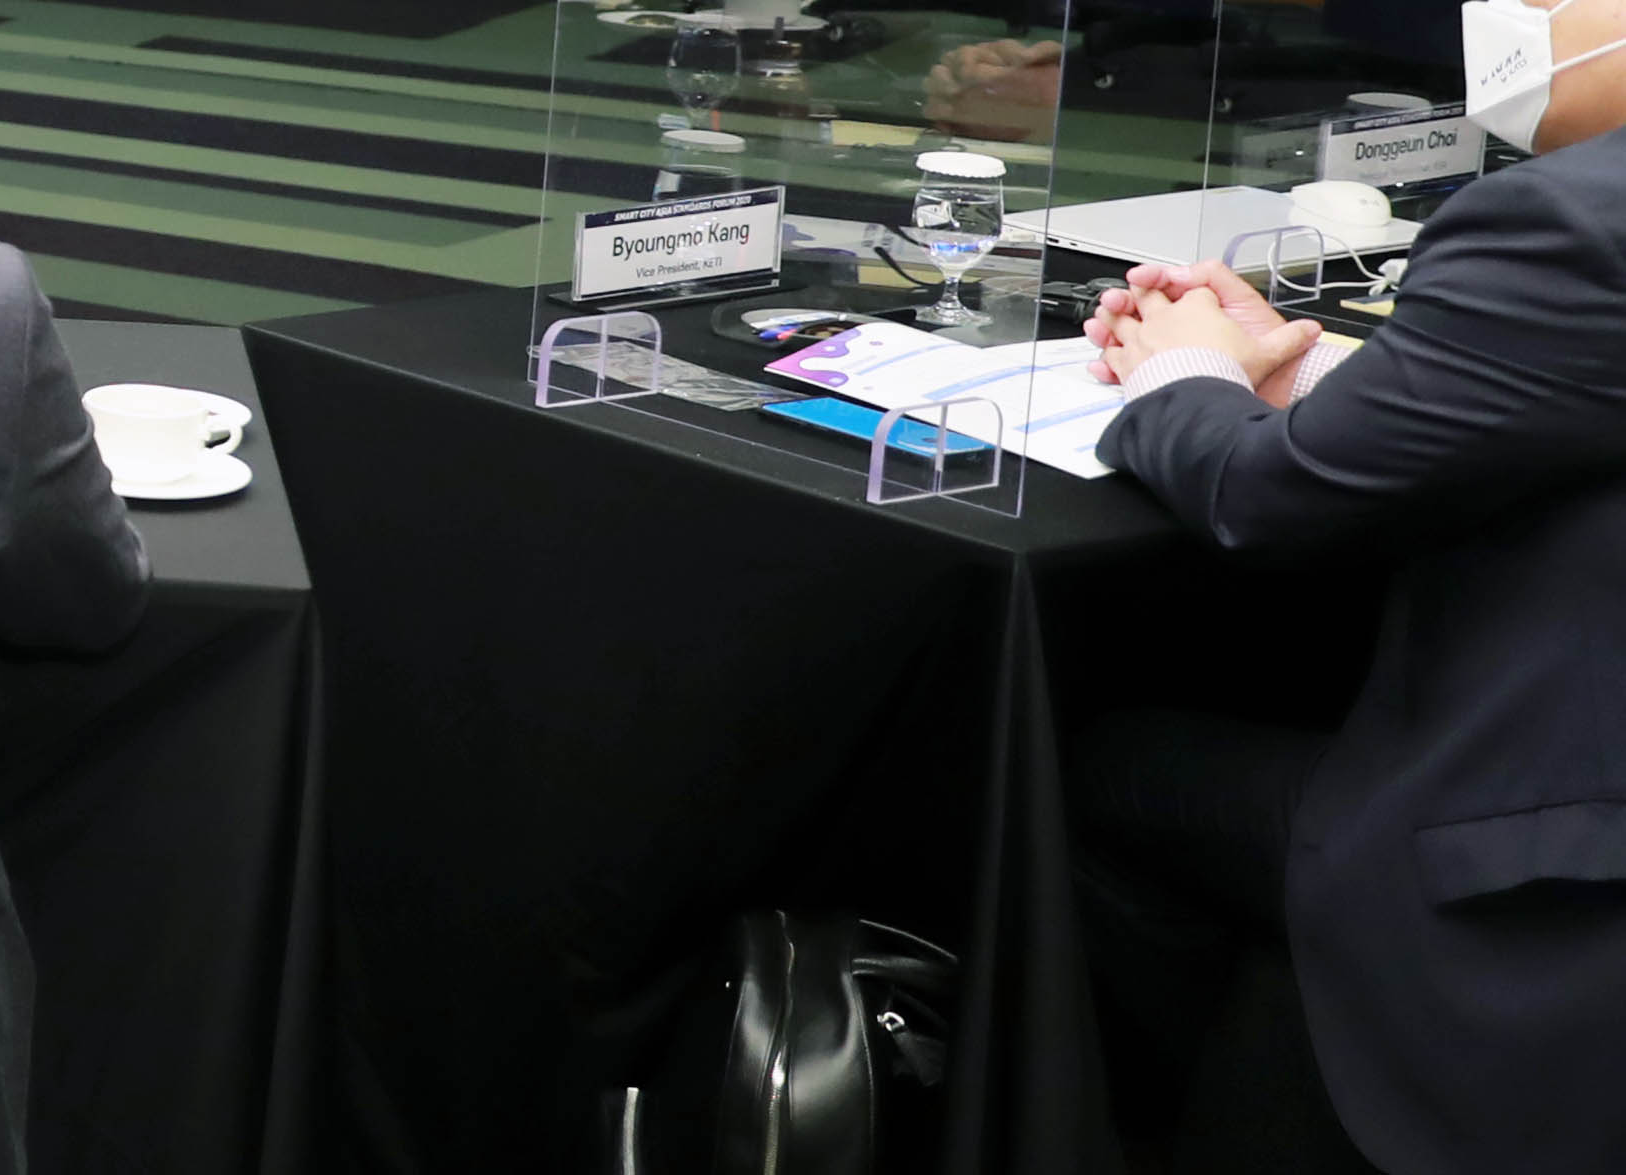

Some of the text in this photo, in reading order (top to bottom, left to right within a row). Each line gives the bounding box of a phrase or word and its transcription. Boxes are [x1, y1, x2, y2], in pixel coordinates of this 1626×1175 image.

[1355, 128, 1458, 161] Donggeun Choi
[614, 211, 638, 222] SMART
[639, 209, 656, 219] CITY
[656, 207, 672, 217] ASIA
[673, 202, 712, 215] STANDARDS
[713, 198, 735, 209] FORUM
[613, 223, 749, 261] Byoungmo Kang
[636, 256, 722, 279] Vice President, KETI
